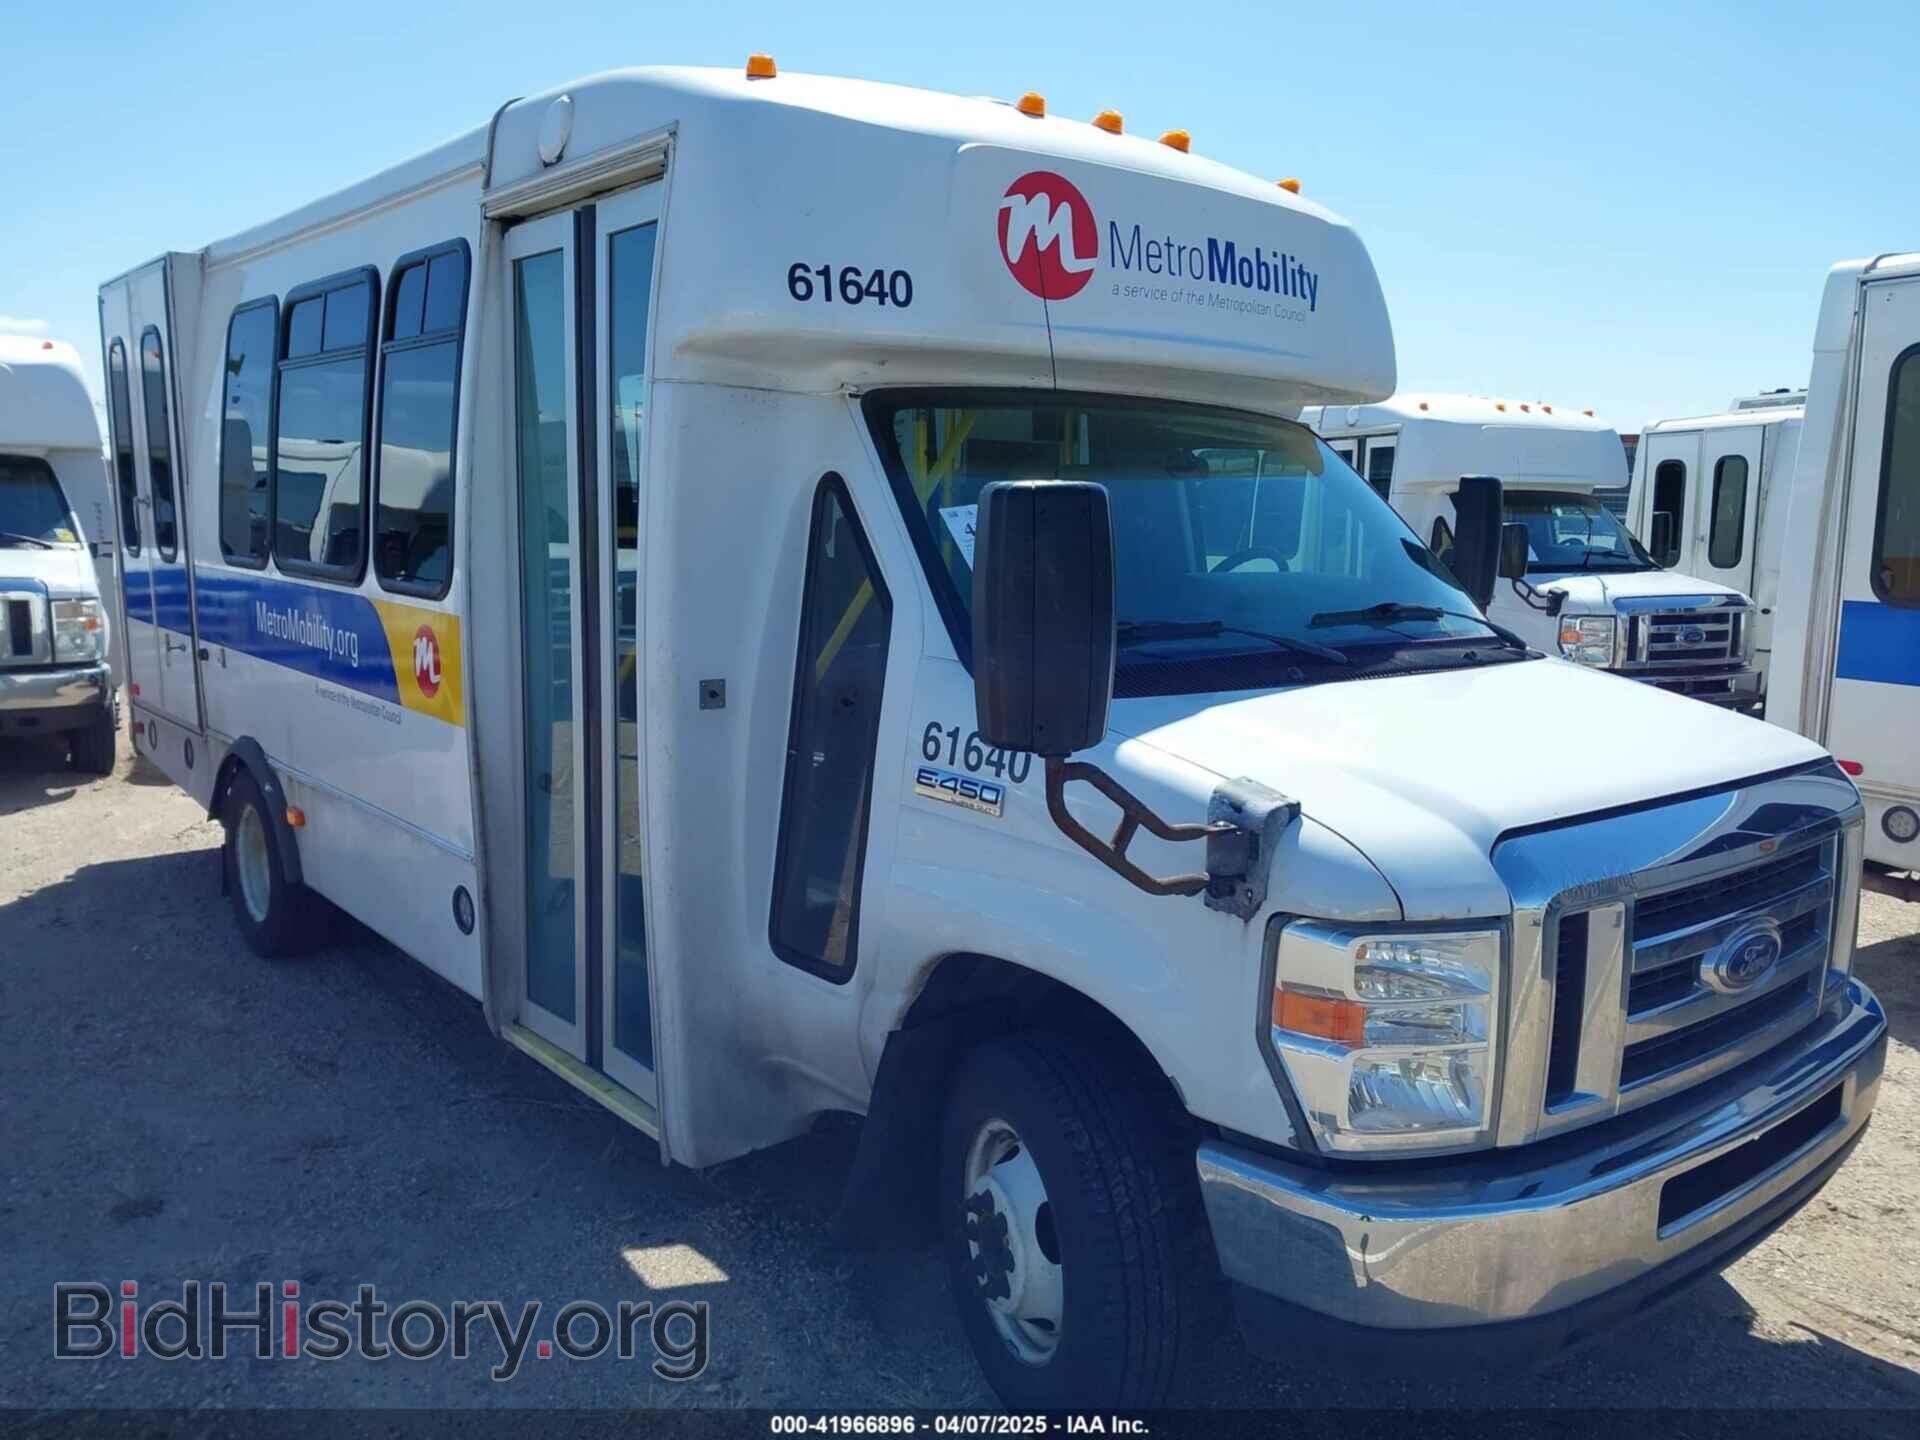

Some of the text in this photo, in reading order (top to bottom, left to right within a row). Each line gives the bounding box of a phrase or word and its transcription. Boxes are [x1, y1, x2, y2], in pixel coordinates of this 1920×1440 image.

[787, 262, 914, 308] 61640
[1109, 220, 1318, 312] MetroMobility
[1111, 283, 1306, 323] a service of the Metropolitan Council
[255, 599, 359, 668] MetroMobility.org
[922, 721, 1032, 784] 61640
[916, 767, 1001, 806] E-450
